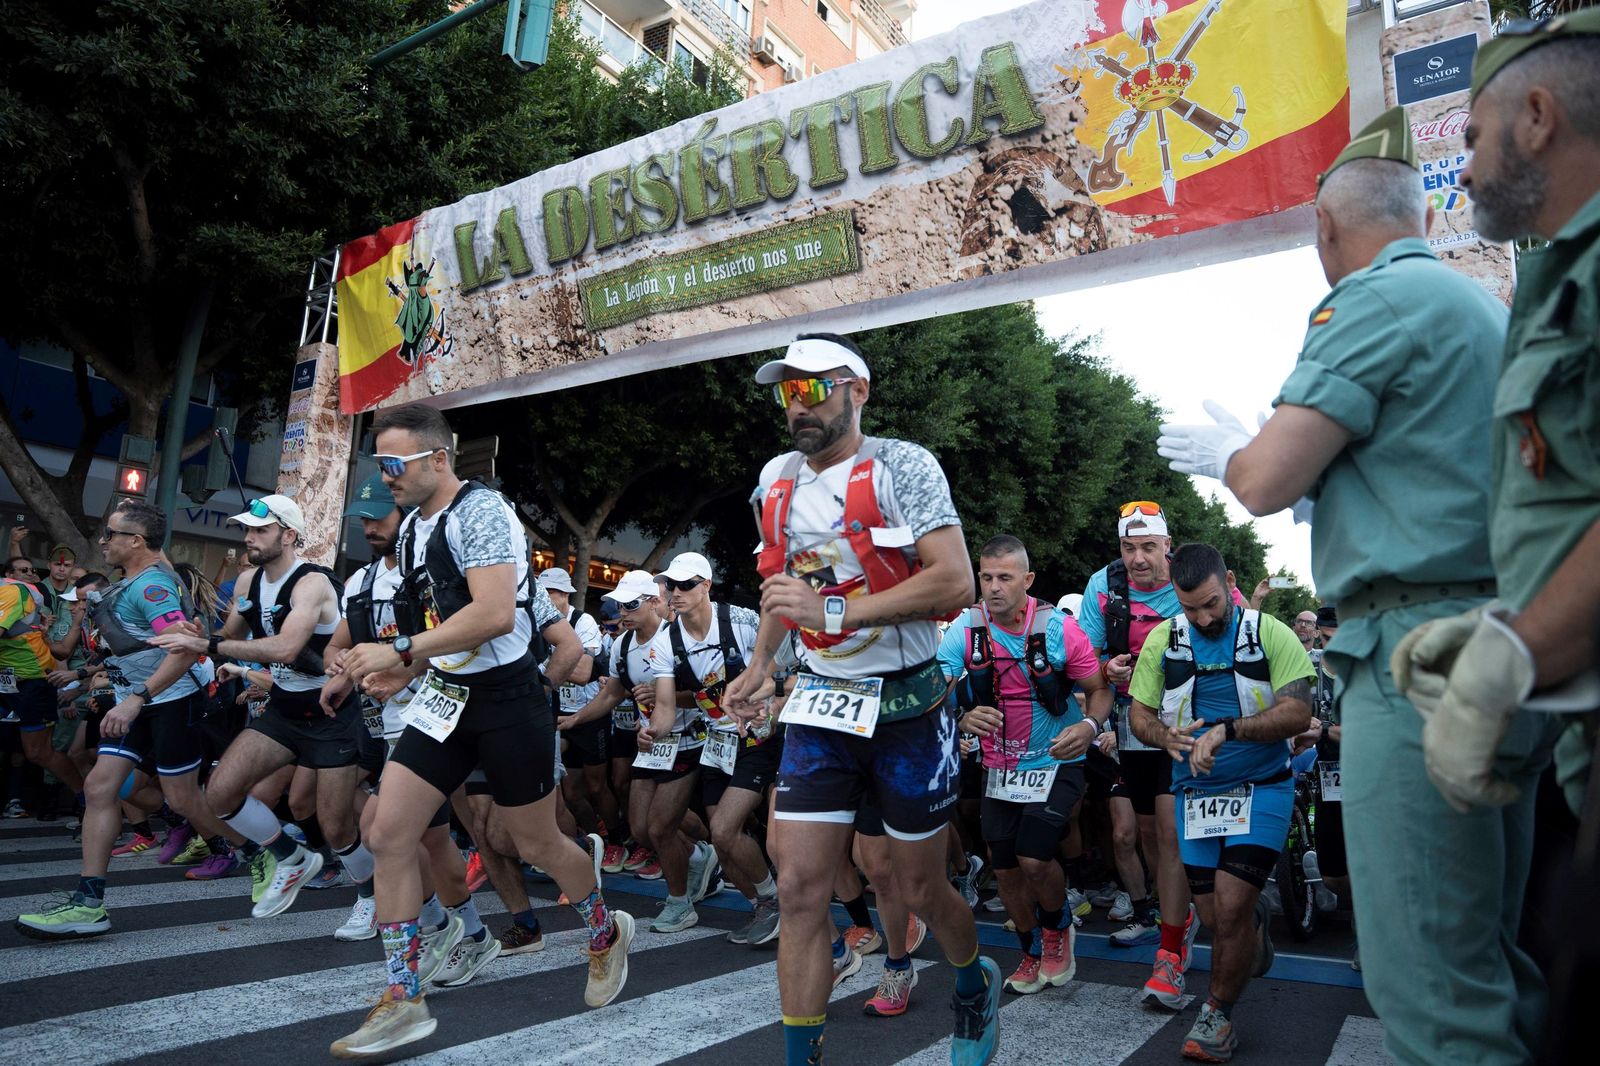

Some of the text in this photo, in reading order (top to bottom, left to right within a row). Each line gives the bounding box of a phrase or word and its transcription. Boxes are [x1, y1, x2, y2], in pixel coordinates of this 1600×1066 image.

[1413, 66, 1461, 85] SENATOR
[454, 41, 1046, 297] LA DESÉRTICA
[1423, 156, 1465, 172] RUP
[604, 239, 823, 308] La Legión y el desierto nos une
[424, 693, 458, 722] 4602
[808, 692, 864, 722] 1521
[1007, 769, 1047, 787] 2102
[1332, 772, 1342, 786] 2
[1198, 798, 1242, 819] 1470
